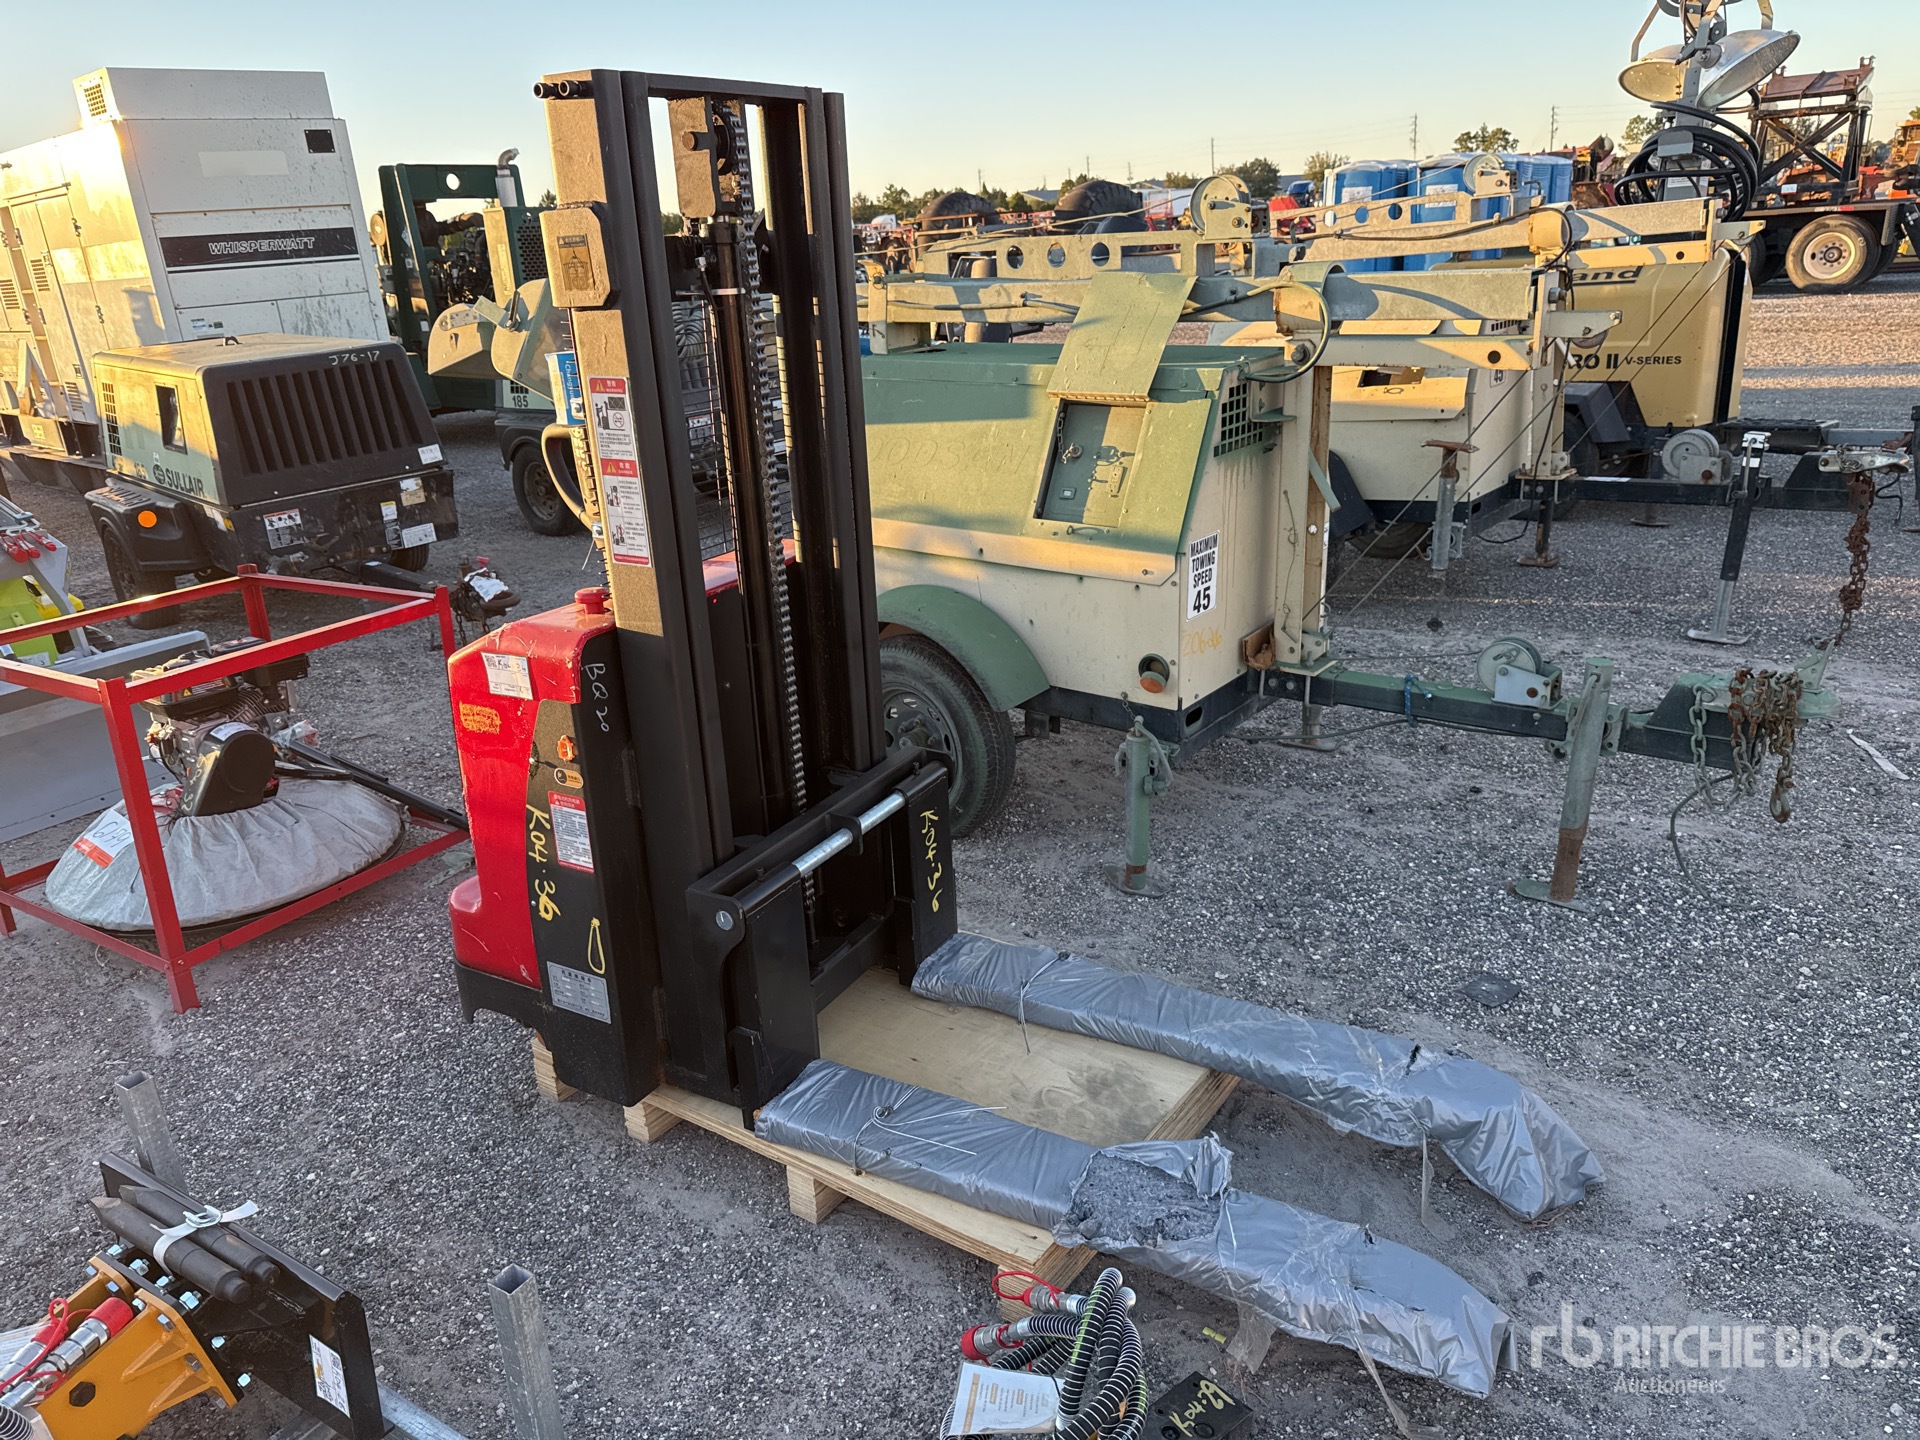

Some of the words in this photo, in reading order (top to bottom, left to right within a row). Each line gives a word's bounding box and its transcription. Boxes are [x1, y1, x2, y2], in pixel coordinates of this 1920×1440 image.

[208, 237, 315, 255] WHISPERWATT
[1625, 355, 1682, 365] V-SERIES
[512, 395, 528, 408] 185
[165, 468, 206, 498] SULLAIR
[1190, 534, 1218, 558] MAXIMUM
[1192, 551, 1216, 573] TOWING
[1193, 568, 1213, 589] SPEED
[1193, 585, 1211, 614] 45
